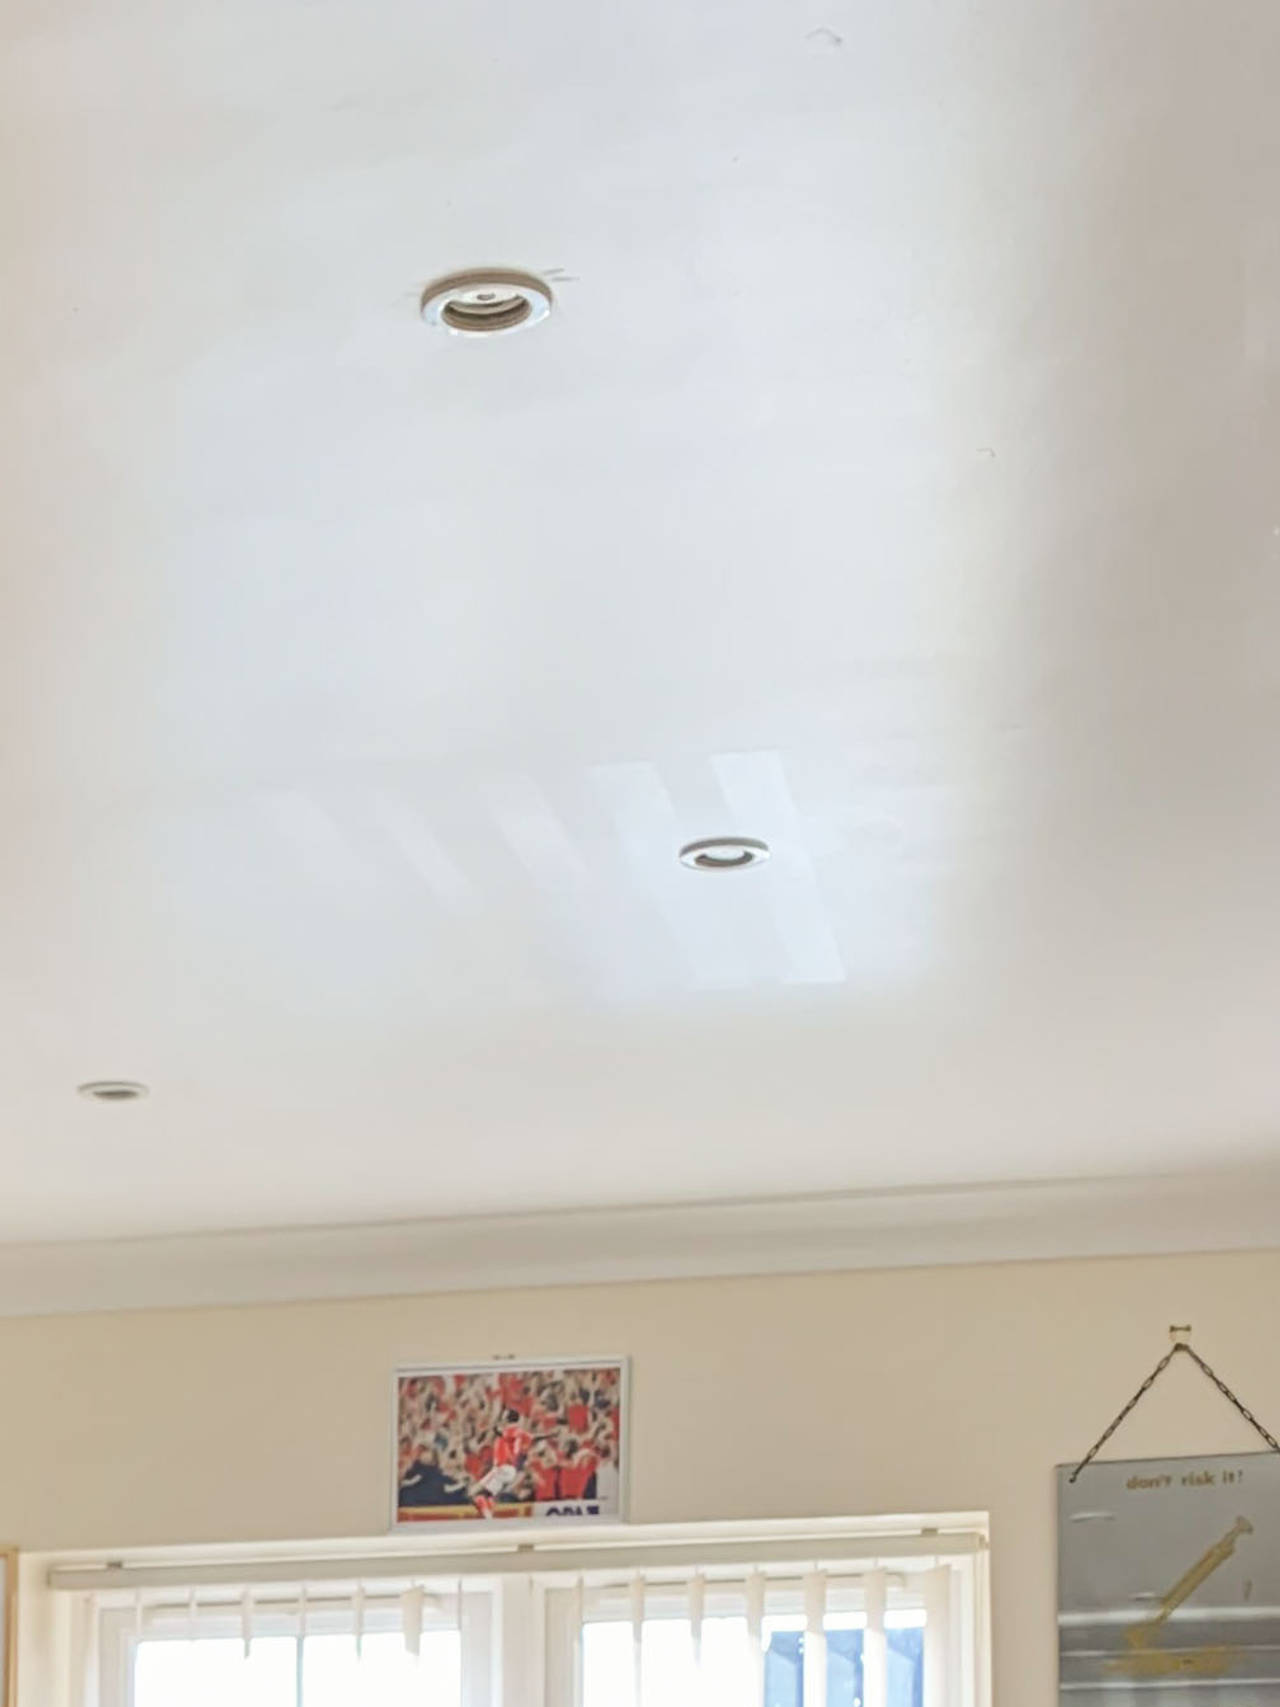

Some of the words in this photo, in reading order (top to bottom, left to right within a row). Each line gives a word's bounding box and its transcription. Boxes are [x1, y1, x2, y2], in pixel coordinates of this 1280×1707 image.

[1125, 1475, 1172, 1490] don't
[1181, 1471, 1215, 1486] risk
[1222, 1470, 1245, 1484] it!
